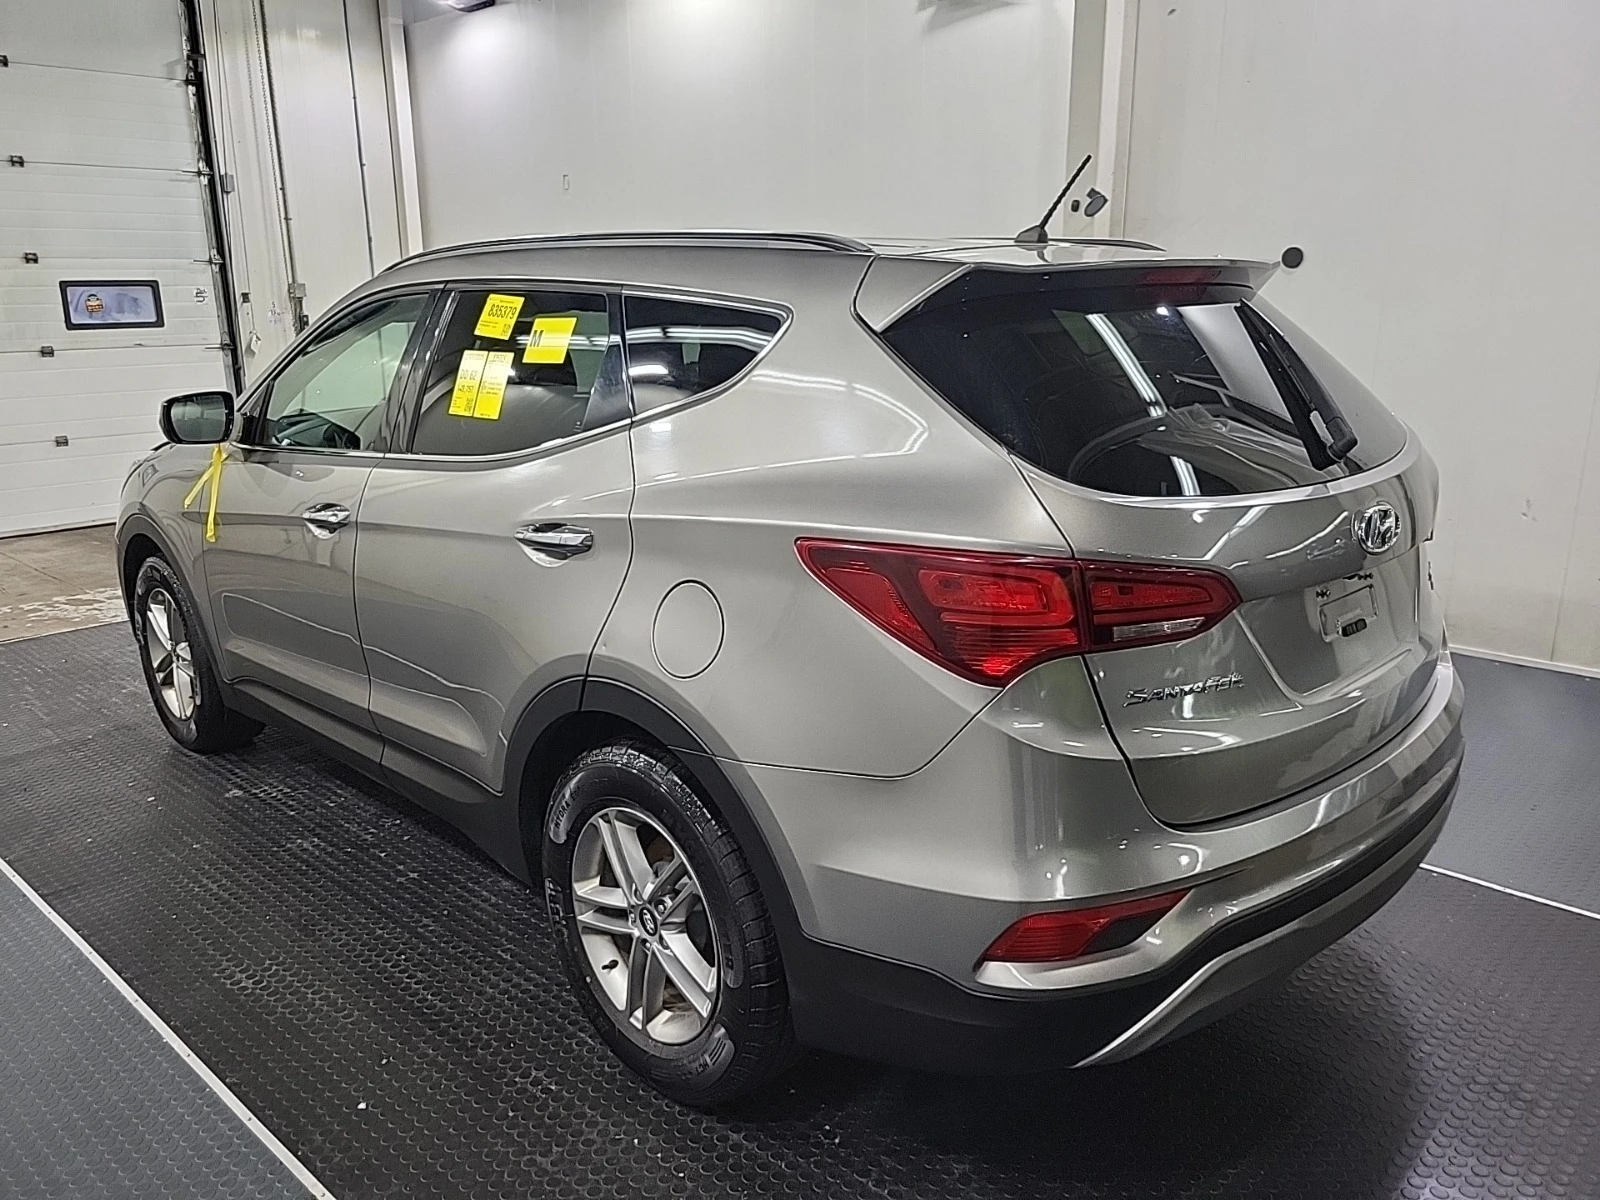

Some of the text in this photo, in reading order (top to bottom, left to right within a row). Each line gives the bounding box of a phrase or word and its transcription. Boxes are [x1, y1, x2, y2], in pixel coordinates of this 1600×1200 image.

[487, 303, 518, 320] 835379
[529, 329, 544, 348] M
[553, 800, 571, 829] HYDRA
